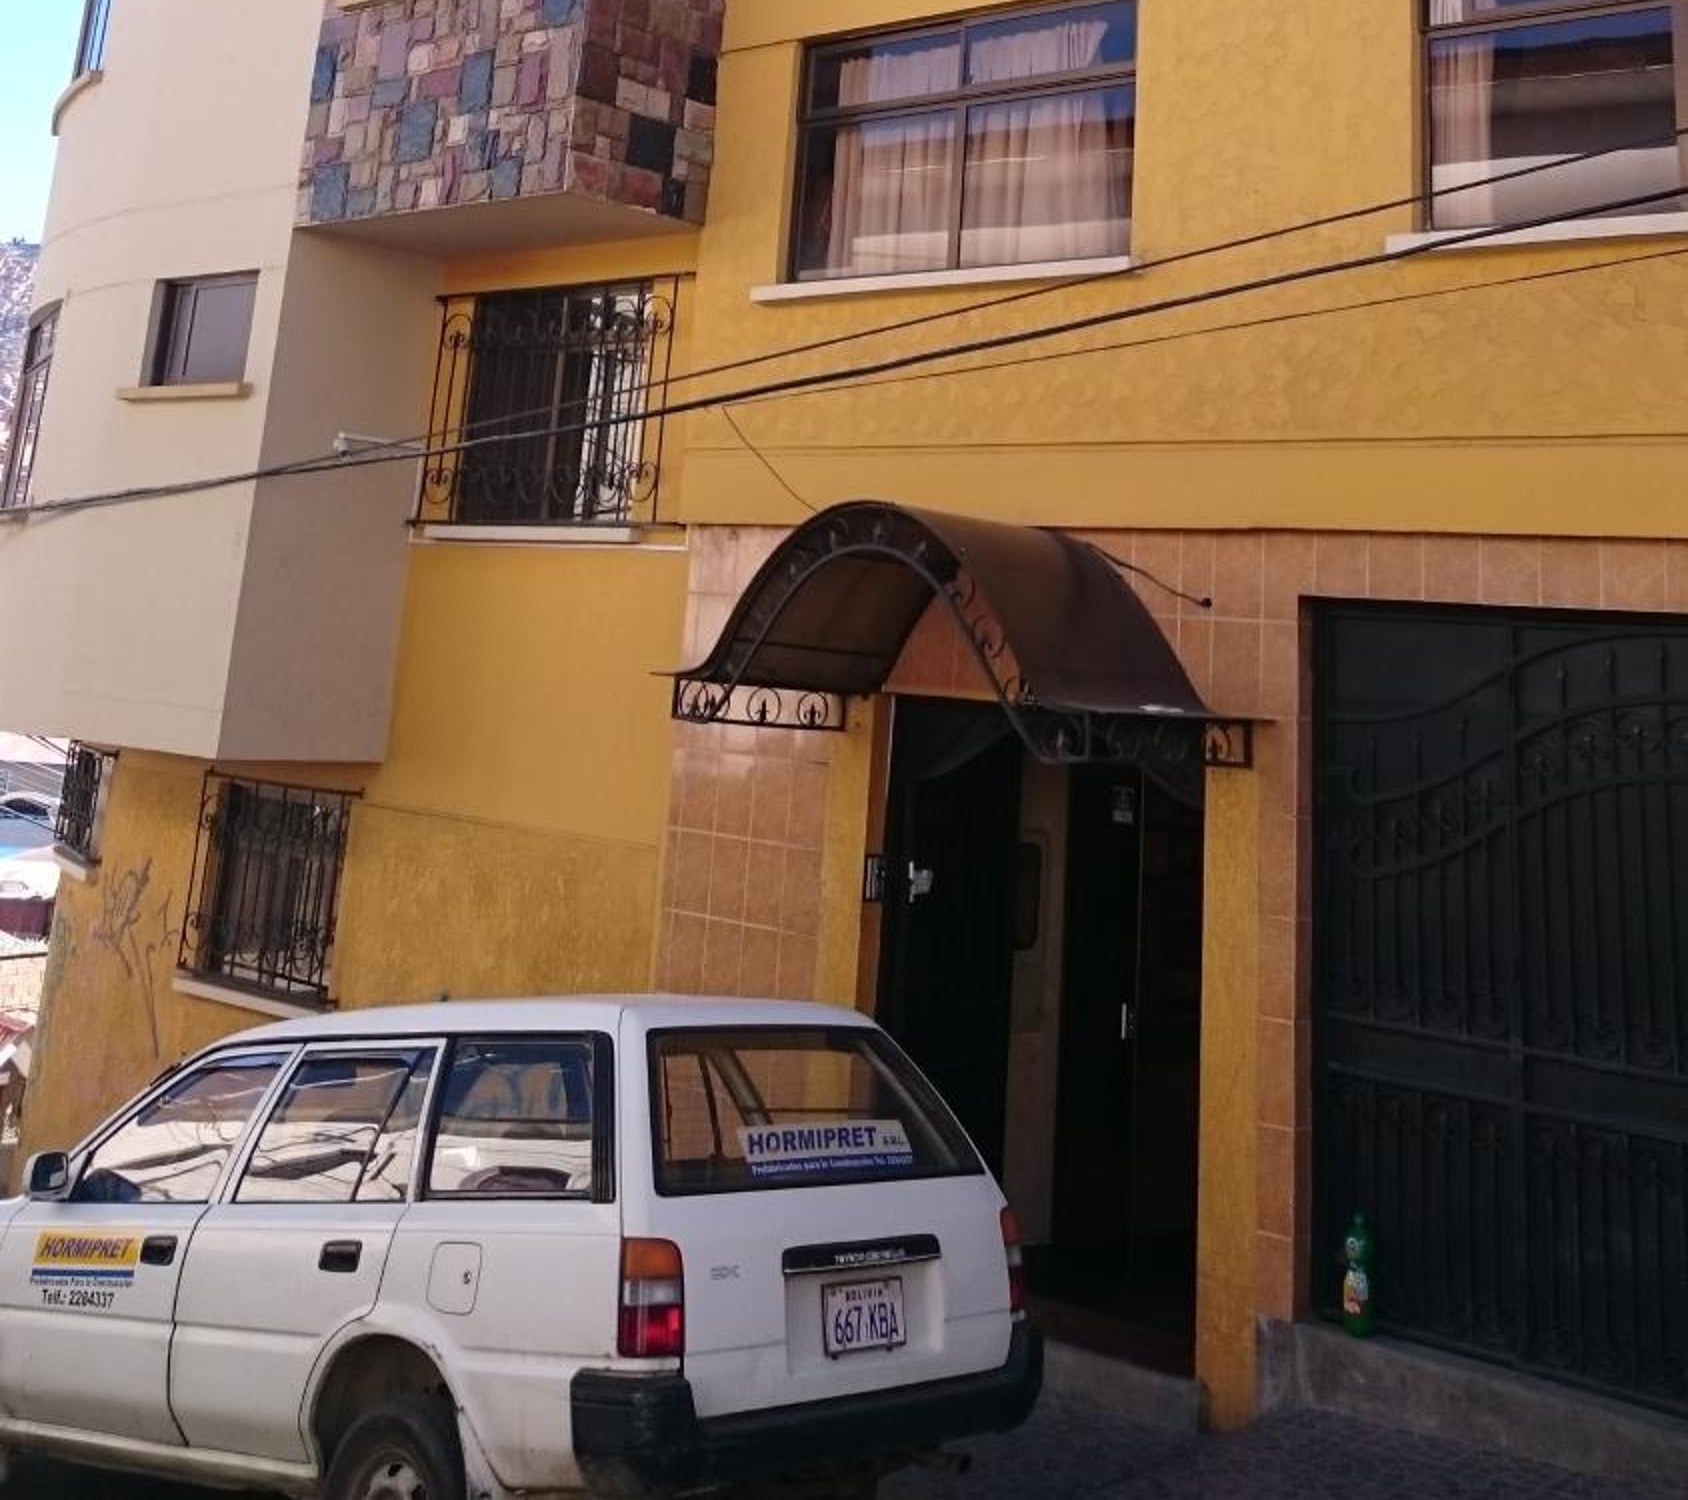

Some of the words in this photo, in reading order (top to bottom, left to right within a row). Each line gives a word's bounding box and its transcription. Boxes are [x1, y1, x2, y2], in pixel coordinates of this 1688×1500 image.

[747, 1126, 877, 1155] HORMIPRET
[41, 1236, 135, 1258] HORMIPRET
[845, 1289, 883, 1302] BOLIVIA
